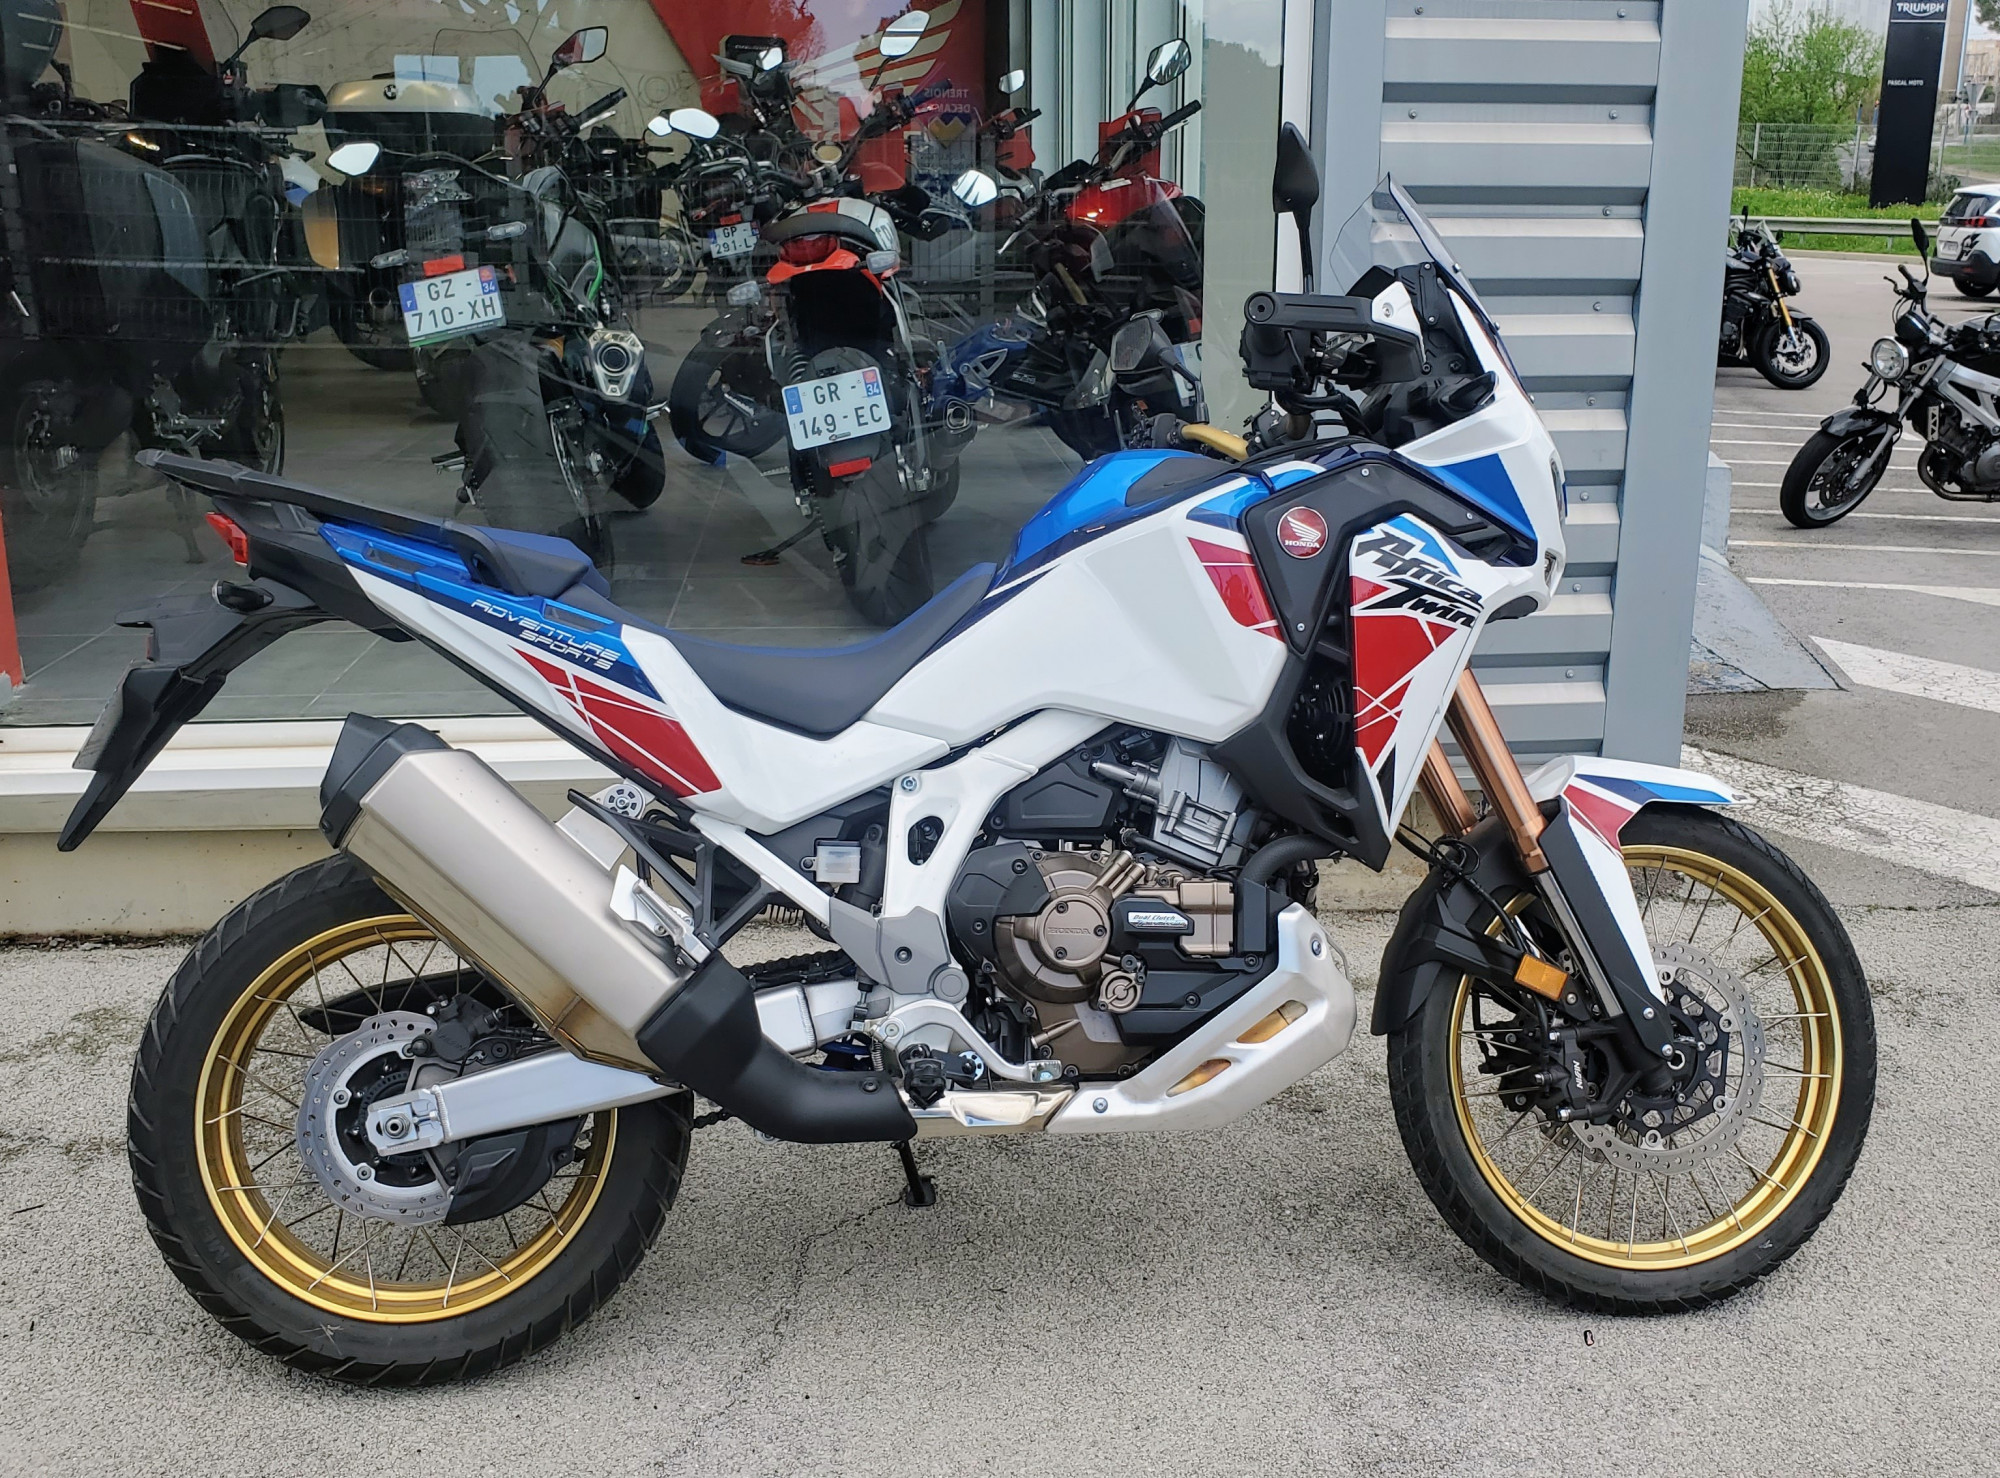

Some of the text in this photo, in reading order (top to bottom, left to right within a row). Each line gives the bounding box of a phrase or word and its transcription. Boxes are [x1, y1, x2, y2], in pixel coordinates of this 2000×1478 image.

[1896, 2, 1946, 15] TRIUMPH
[722, 226, 737, 238] GP
[714, 238, 757, 254] 291-L
[427, 279, 455, 301] GZ
[482, 281, 495, 293] 34
[813, 382, 841, 405] GR
[866, 383, 880, 396] 34
[1284, 539, 1320, 548] HONDA
[1355, 529, 1483, 604] Africa
[1358, 578, 1485, 628] Twin
[471, 599, 621, 662] ADVENTURE
[519, 629, 614, 670] SPORTS
[1048, 927, 1091, 935] HONDA
